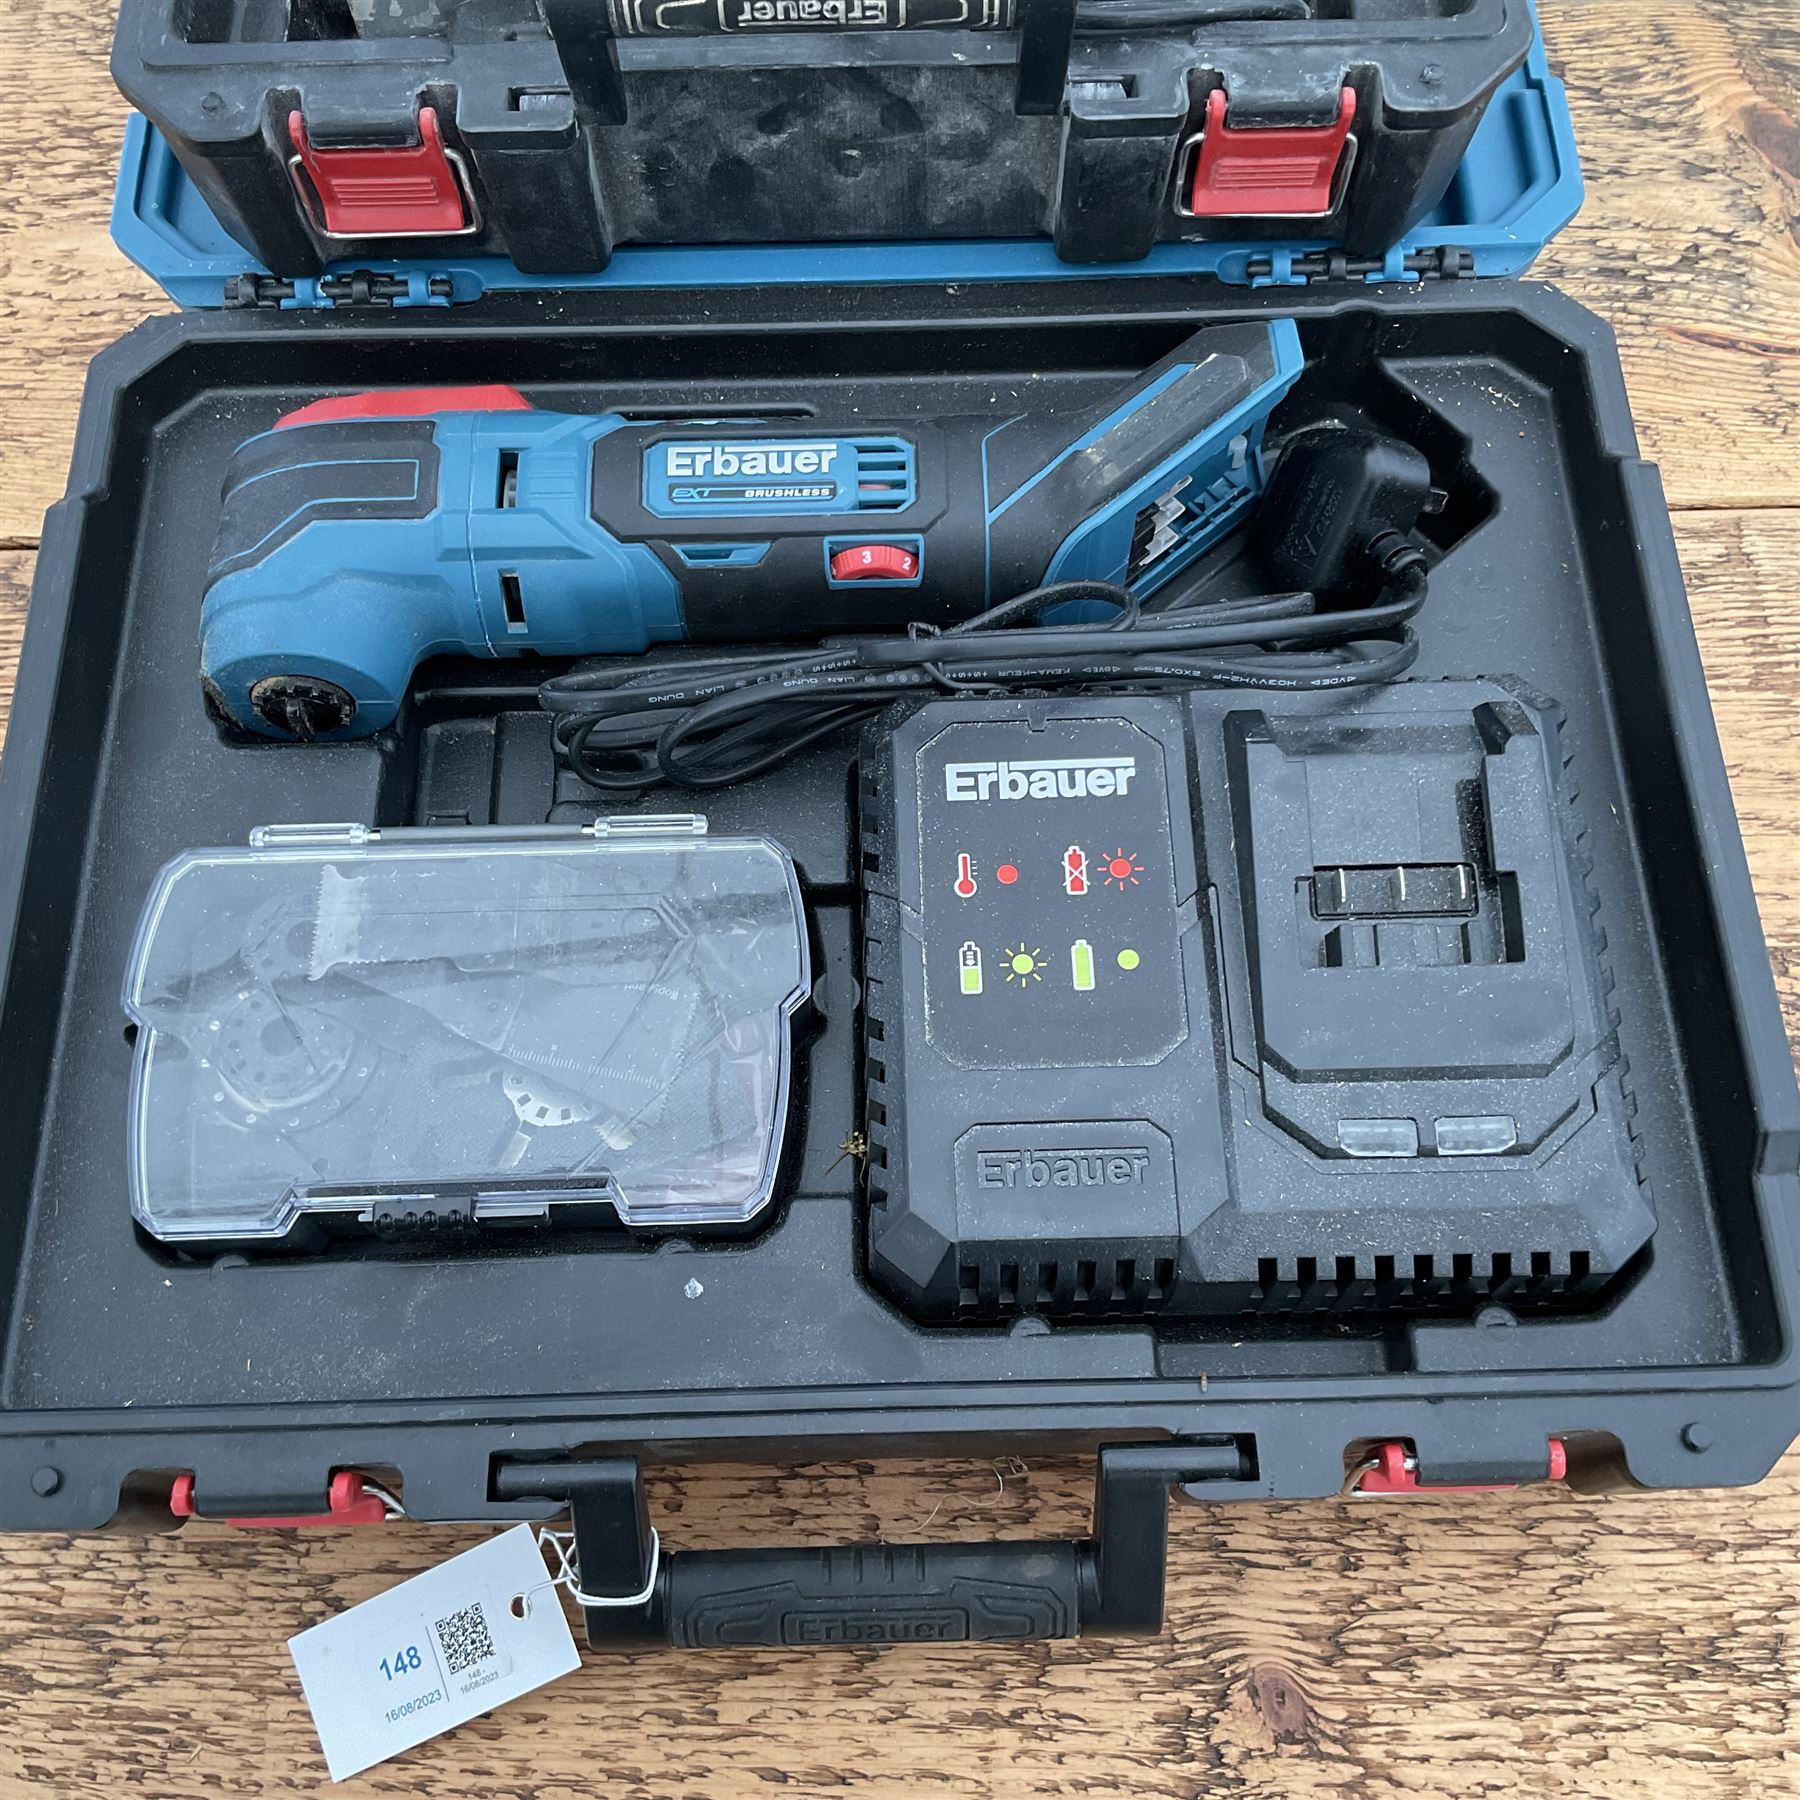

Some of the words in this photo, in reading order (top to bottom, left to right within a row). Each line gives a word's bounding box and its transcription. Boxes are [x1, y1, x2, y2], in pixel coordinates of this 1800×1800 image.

[738, 0, 888, 26] Erbauer
[666, 443, 838, 477] Erbauer
[744, 488, 831, 498] BRUSHLESS
[861, 550, 873, 565] 3
[902, 556, 912, 571] 2
[695, 684, 725, 696] LIAN
[827, 676, 855, 684] LIAN
[945, 757, 1136, 802] Erbauer
[976, 1146, 1150, 1189] Erbauer
[798, 1615, 953, 1641] Erbauer
[379, 1645, 422, 1681] 148
[468, 1668, 482, 1681] 148
[460, 1671, 499, 1694] 16/08/2023
[385, 1688, 442, 1723] 16/08/2023
